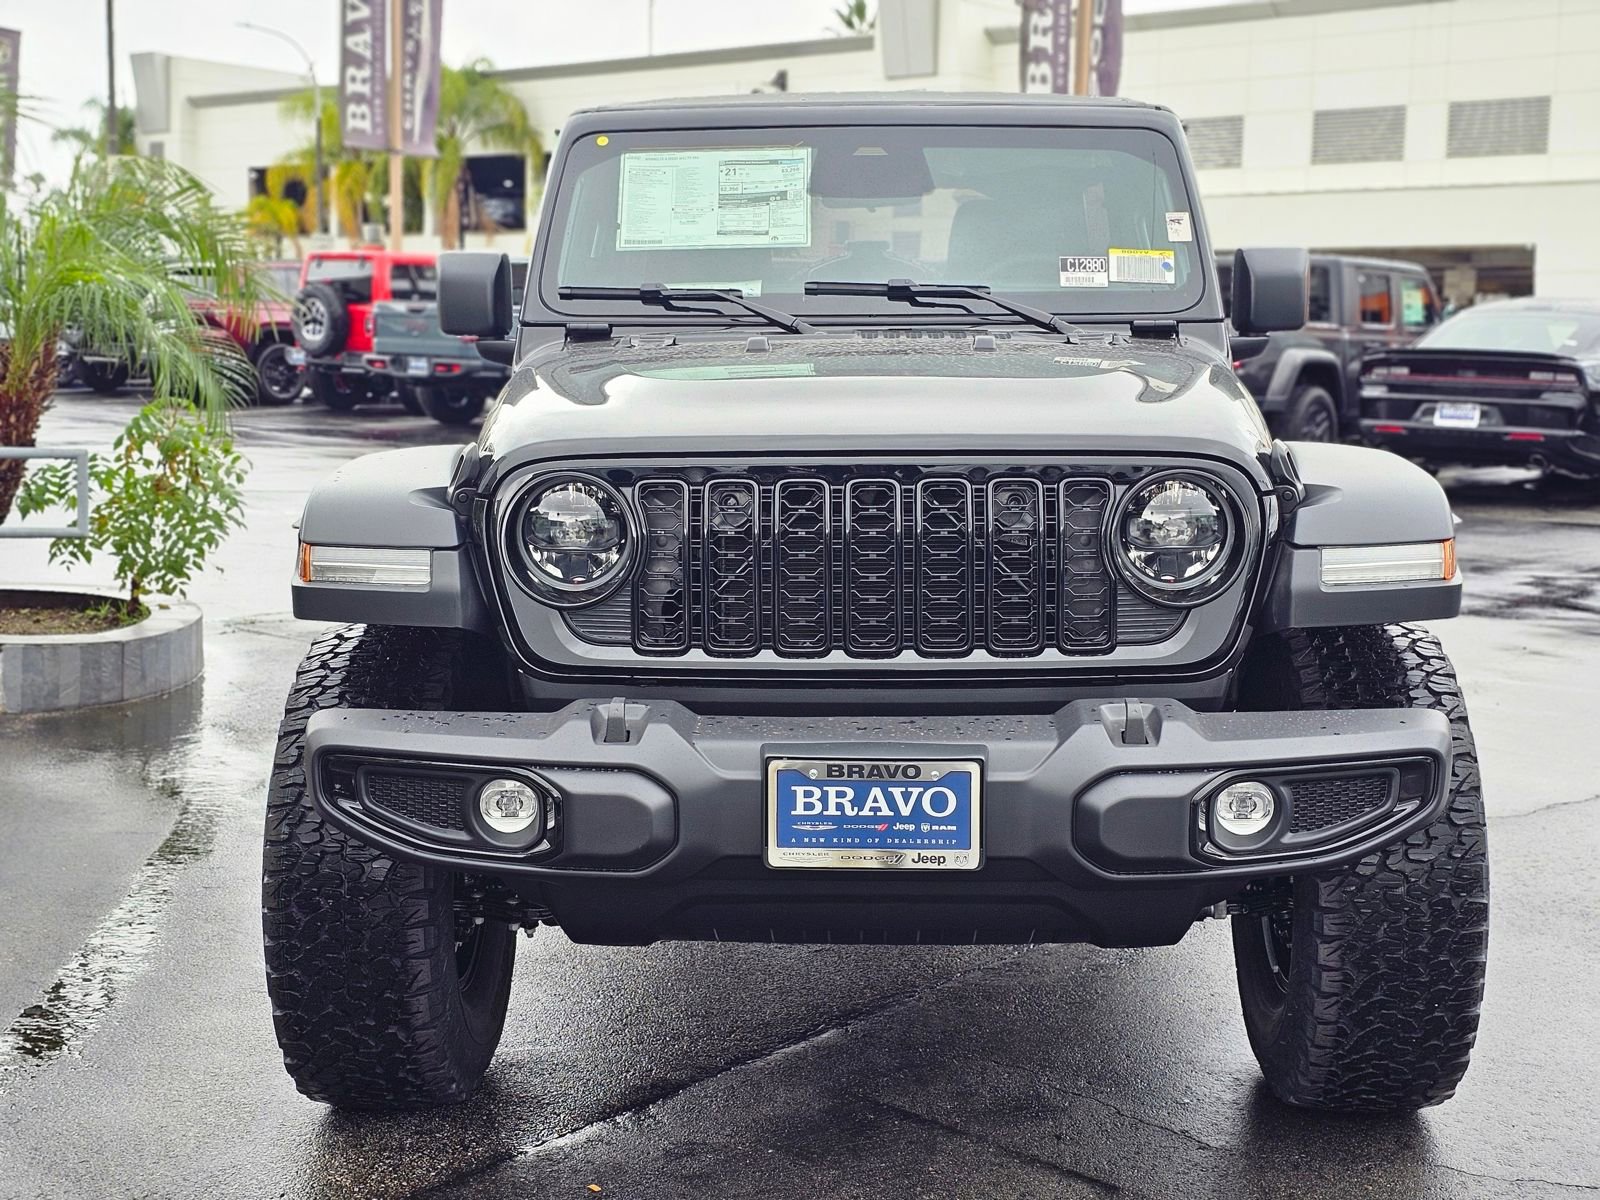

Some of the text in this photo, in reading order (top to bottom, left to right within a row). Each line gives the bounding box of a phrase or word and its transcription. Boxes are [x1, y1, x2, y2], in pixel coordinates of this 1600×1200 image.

[1067, 258, 1106, 272] C12880
[826, 764, 922, 779] BRAVO
[791, 785, 957, 817] BRAVO
[893, 822, 915, 831] Jeep
[911, 852, 947, 866] Jeep
